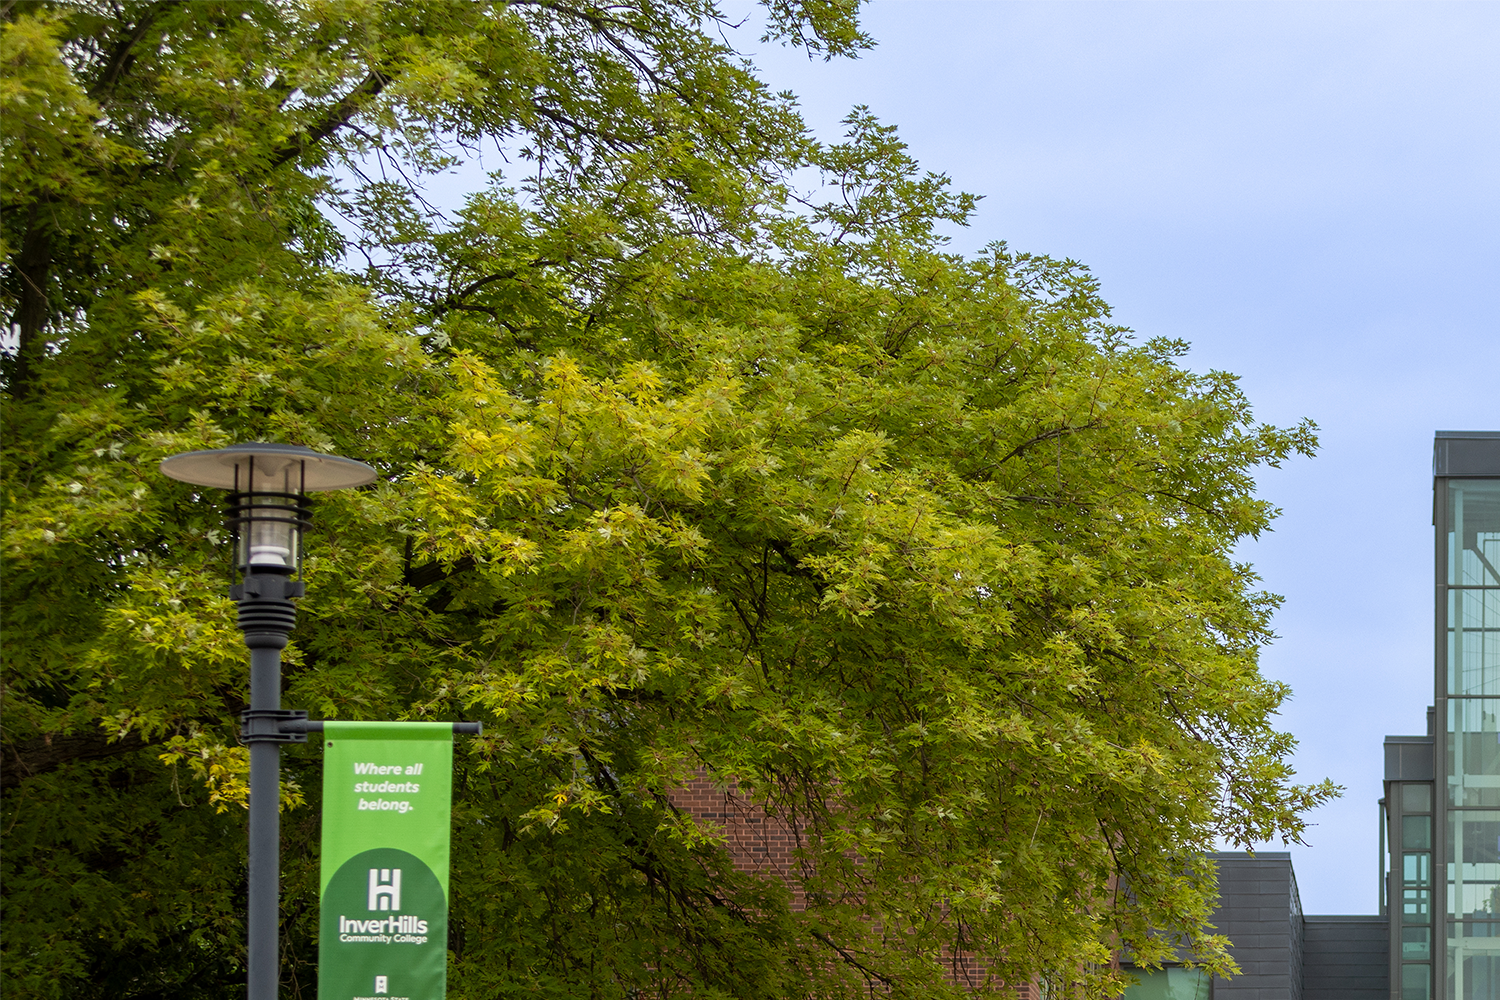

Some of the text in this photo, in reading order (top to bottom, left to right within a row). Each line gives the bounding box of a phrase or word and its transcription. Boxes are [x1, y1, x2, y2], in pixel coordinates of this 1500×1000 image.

[354, 762, 424, 776] Where all
[354, 780, 420, 794] students
[358, 798, 414, 813] belong.
[339, 915, 428, 934] InverHills
[339, 933, 428, 945] Community College
